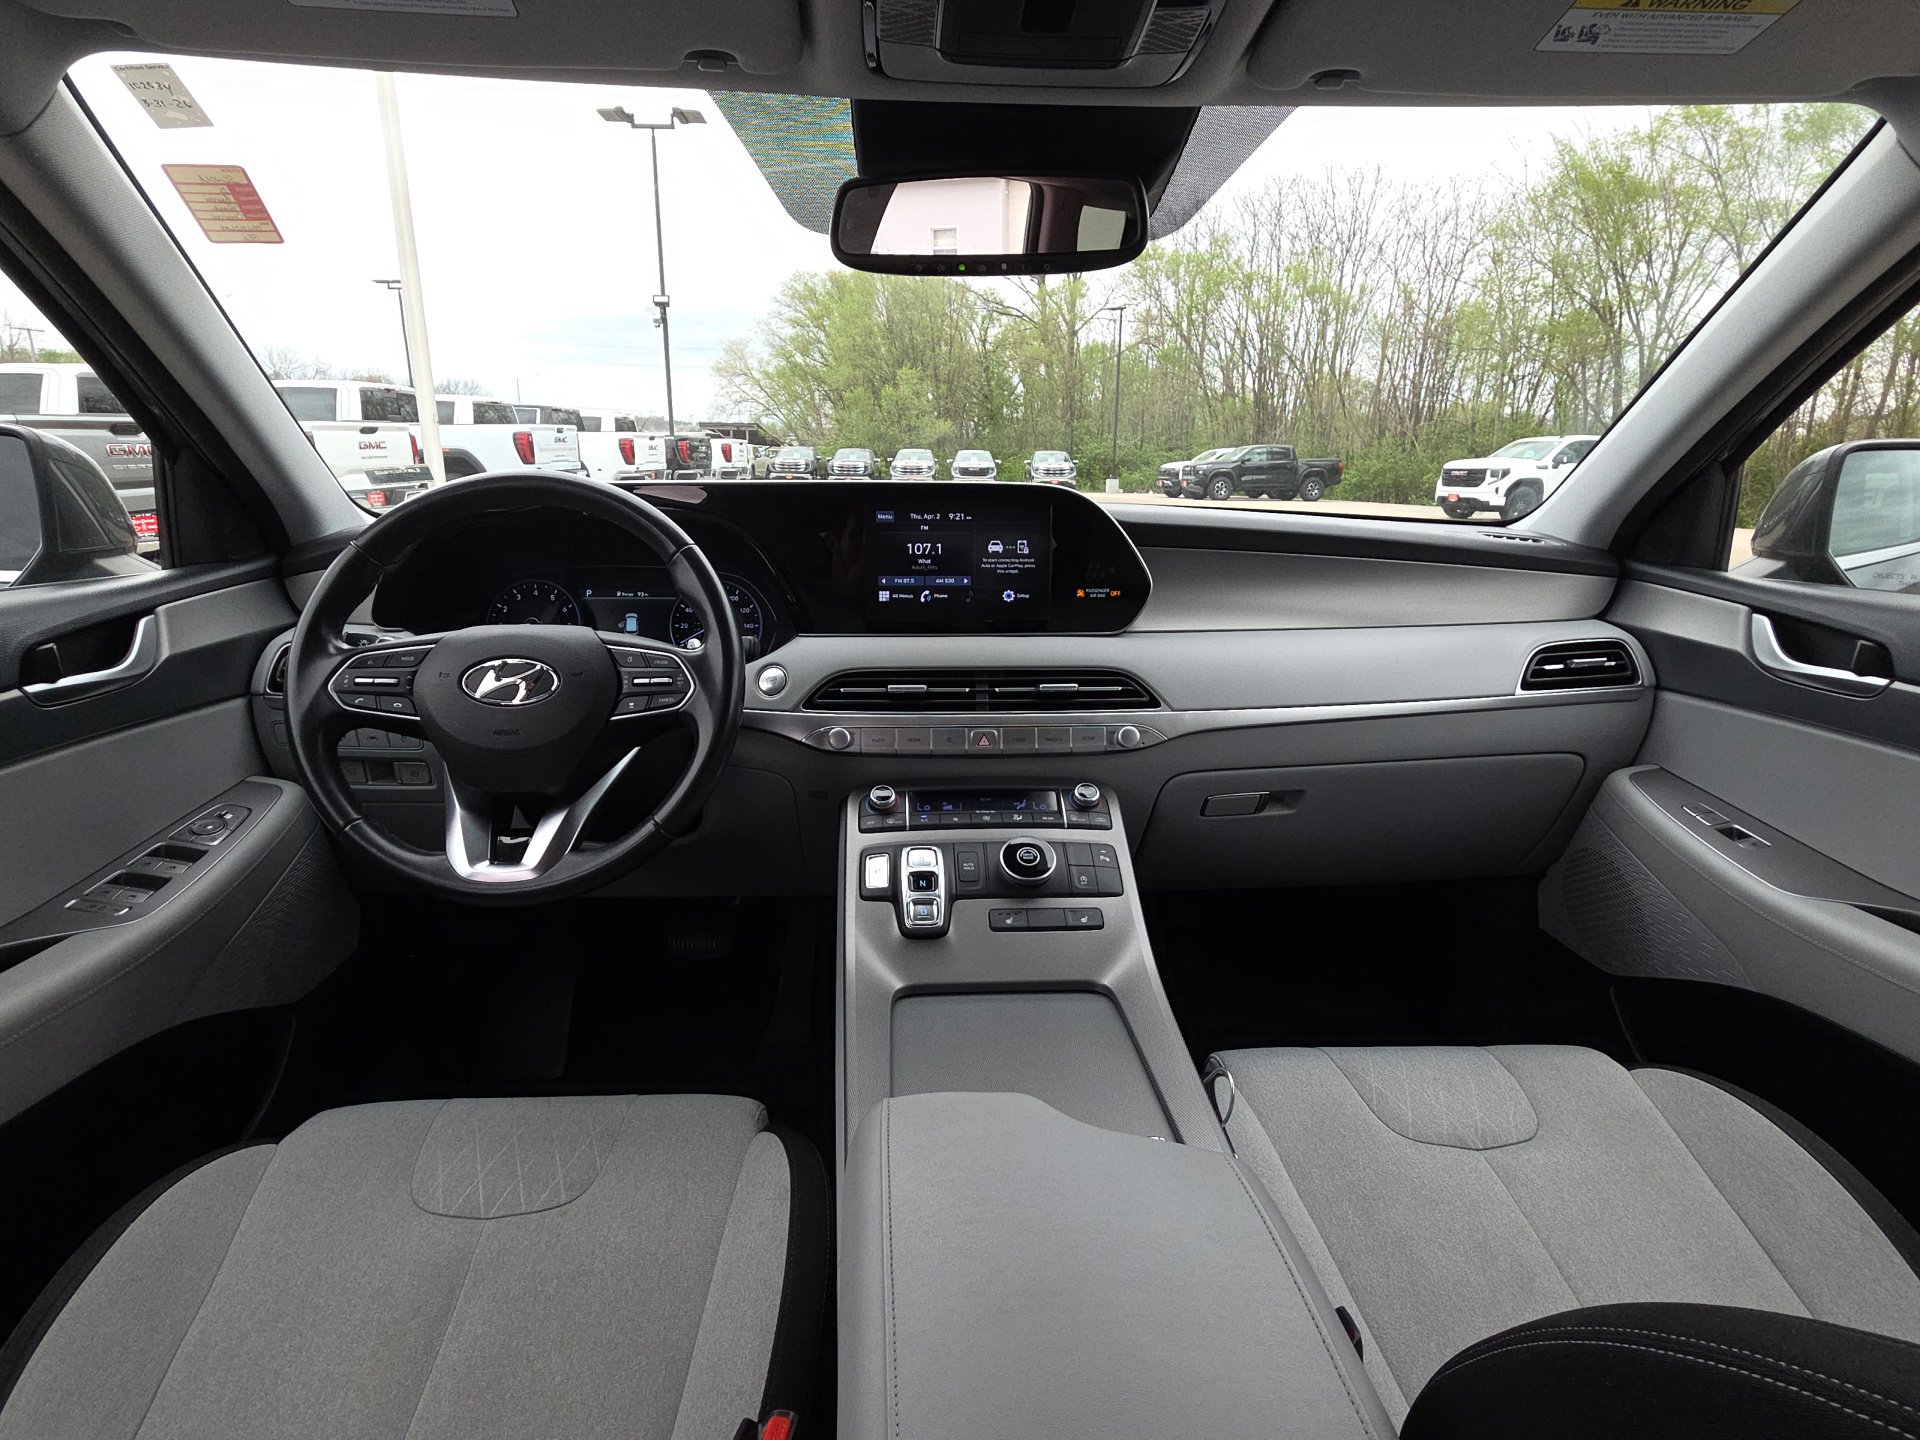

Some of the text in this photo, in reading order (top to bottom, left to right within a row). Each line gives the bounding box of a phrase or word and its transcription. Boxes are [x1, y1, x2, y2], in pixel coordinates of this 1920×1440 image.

[1647, 0, 1750, 11] WARNING
[1621, 12, 1647, 20] WITH
[1648, 13, 1704, 22] ADVANCED
[359, 441, 387, 450] GMC
[923, 513, 936, 521] Apr.
[906, 543, 942, 555] 107.1
[586, 589, 592, 597] P
[503, 605, 508, 613] 2
[919, 879, 926, 887] N
